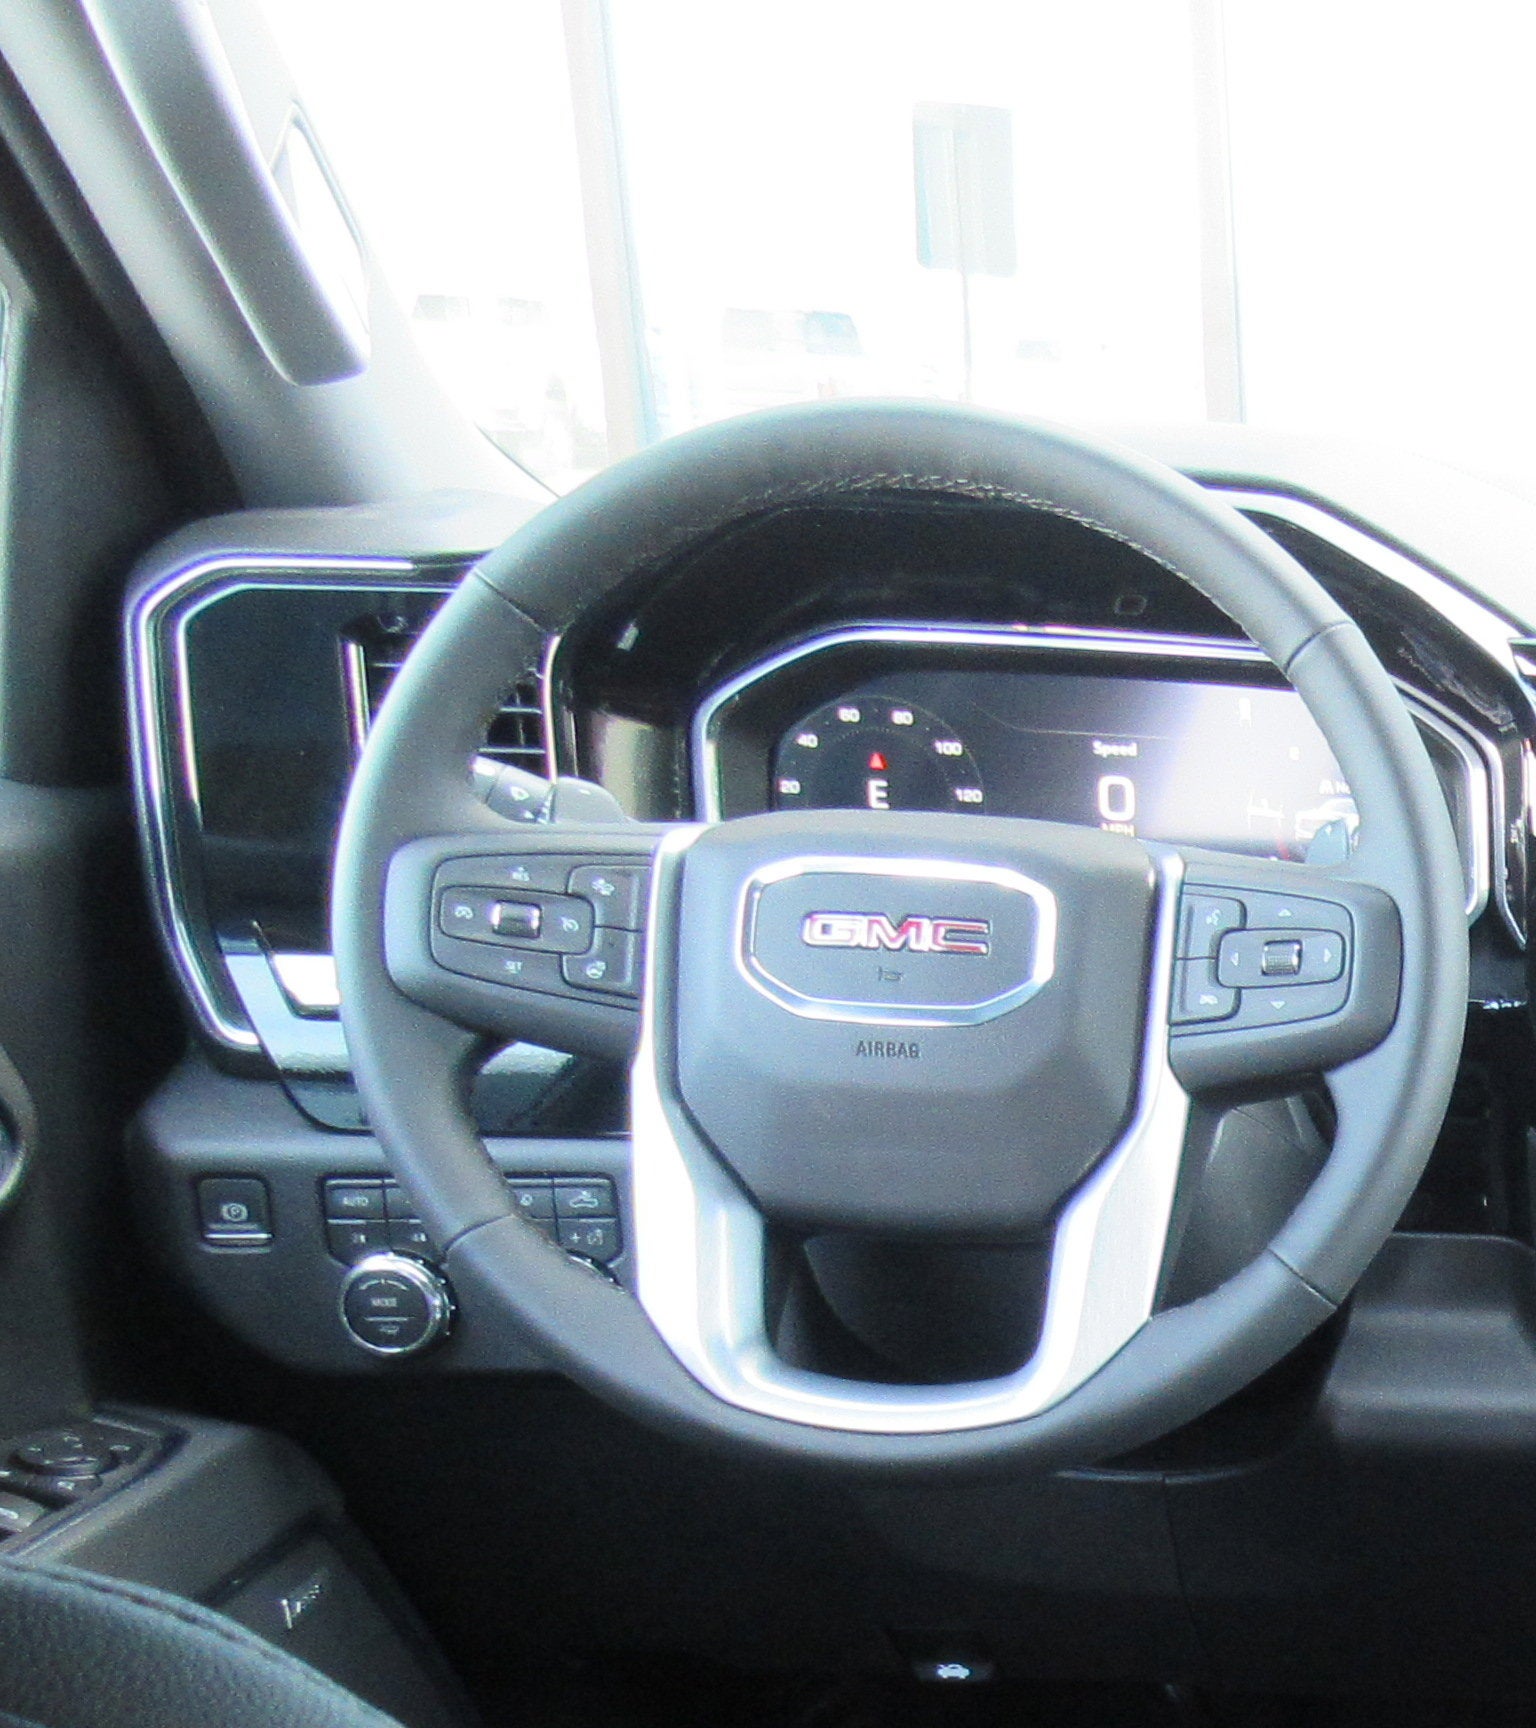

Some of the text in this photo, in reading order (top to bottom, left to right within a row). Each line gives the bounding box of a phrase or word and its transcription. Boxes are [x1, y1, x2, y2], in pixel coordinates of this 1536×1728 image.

[838, 707, 860, 723] 60
[891, 710, 914, 725] 80
[796, 734, 818, 748] 40
[934, 740, 963, 756] 100
[1092, 740, 1138, 758] Speed
[779, 779, 801, 794] 20
[868, 779, 890, 810] E
[954, 788, 983, 803] 120
[1098, 775, 1135, 821] 0
[802, 911, 990, 954] GMC
[856, 1040, 920, 1059] AIRBAG
